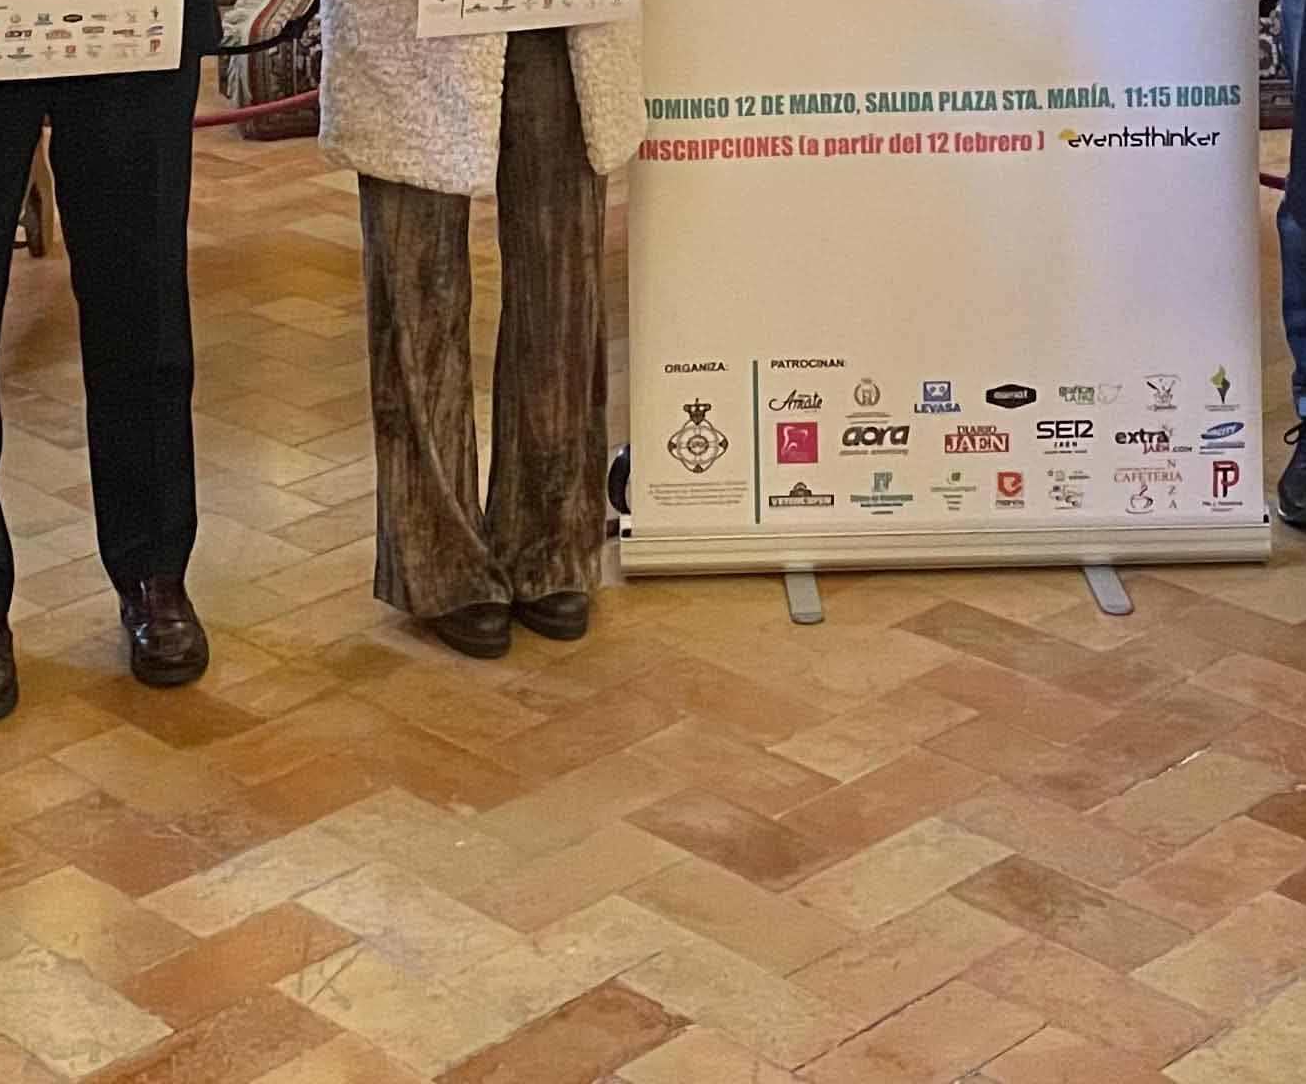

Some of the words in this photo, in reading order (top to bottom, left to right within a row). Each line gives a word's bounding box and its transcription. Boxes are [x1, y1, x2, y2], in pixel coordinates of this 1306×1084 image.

[735, 96, 756, 117] 12
[762, 95, 786, 116] DE
[790, 93, 860, 116] MARZO,
[865, 91, 934, 113] SALIDA
[939, 89, 997, 112] PLAZA
[1002, 89, 1042, 111] STA.
[1124, 86, 1171, 108] 11:15
[1176, 85, 1241, 108] HORAS
[639, 136, 793, 162] INSCRIPCIONES
[824, 133, 884, 161] partir
[889, 132, 922, 154] del
[927, 132, 949, 154] 12
[954, 130, 1032, 154] febrero
[1069, 126, 1221, 150] eventsthinker
[914, 402, 961, 414] LEVASA
[842, 425, 910, 446] aora
[957, 425, 997, 435] DIARIO
[1114, 427, 1169, 445] extra
